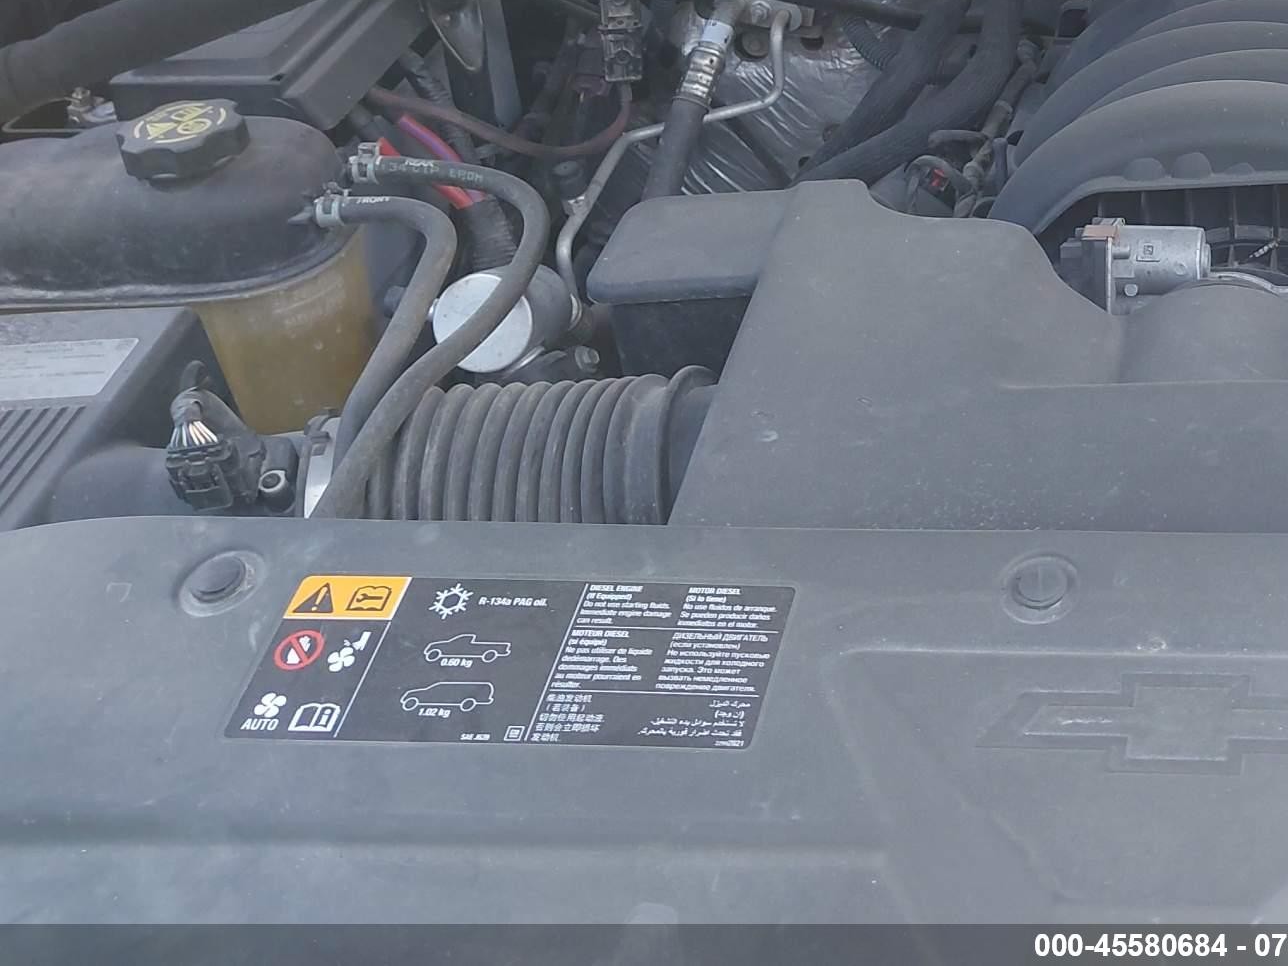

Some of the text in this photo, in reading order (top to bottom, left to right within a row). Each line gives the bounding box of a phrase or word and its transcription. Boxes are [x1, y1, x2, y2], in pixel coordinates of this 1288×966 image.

[478, 597, 512, 606] R-134a
[513, 597, 533, 606] PAG
[460, 658, 473, 668] kg
[438, 708, 451, 718] kg
[240, 718, 280, 731] AUTO
